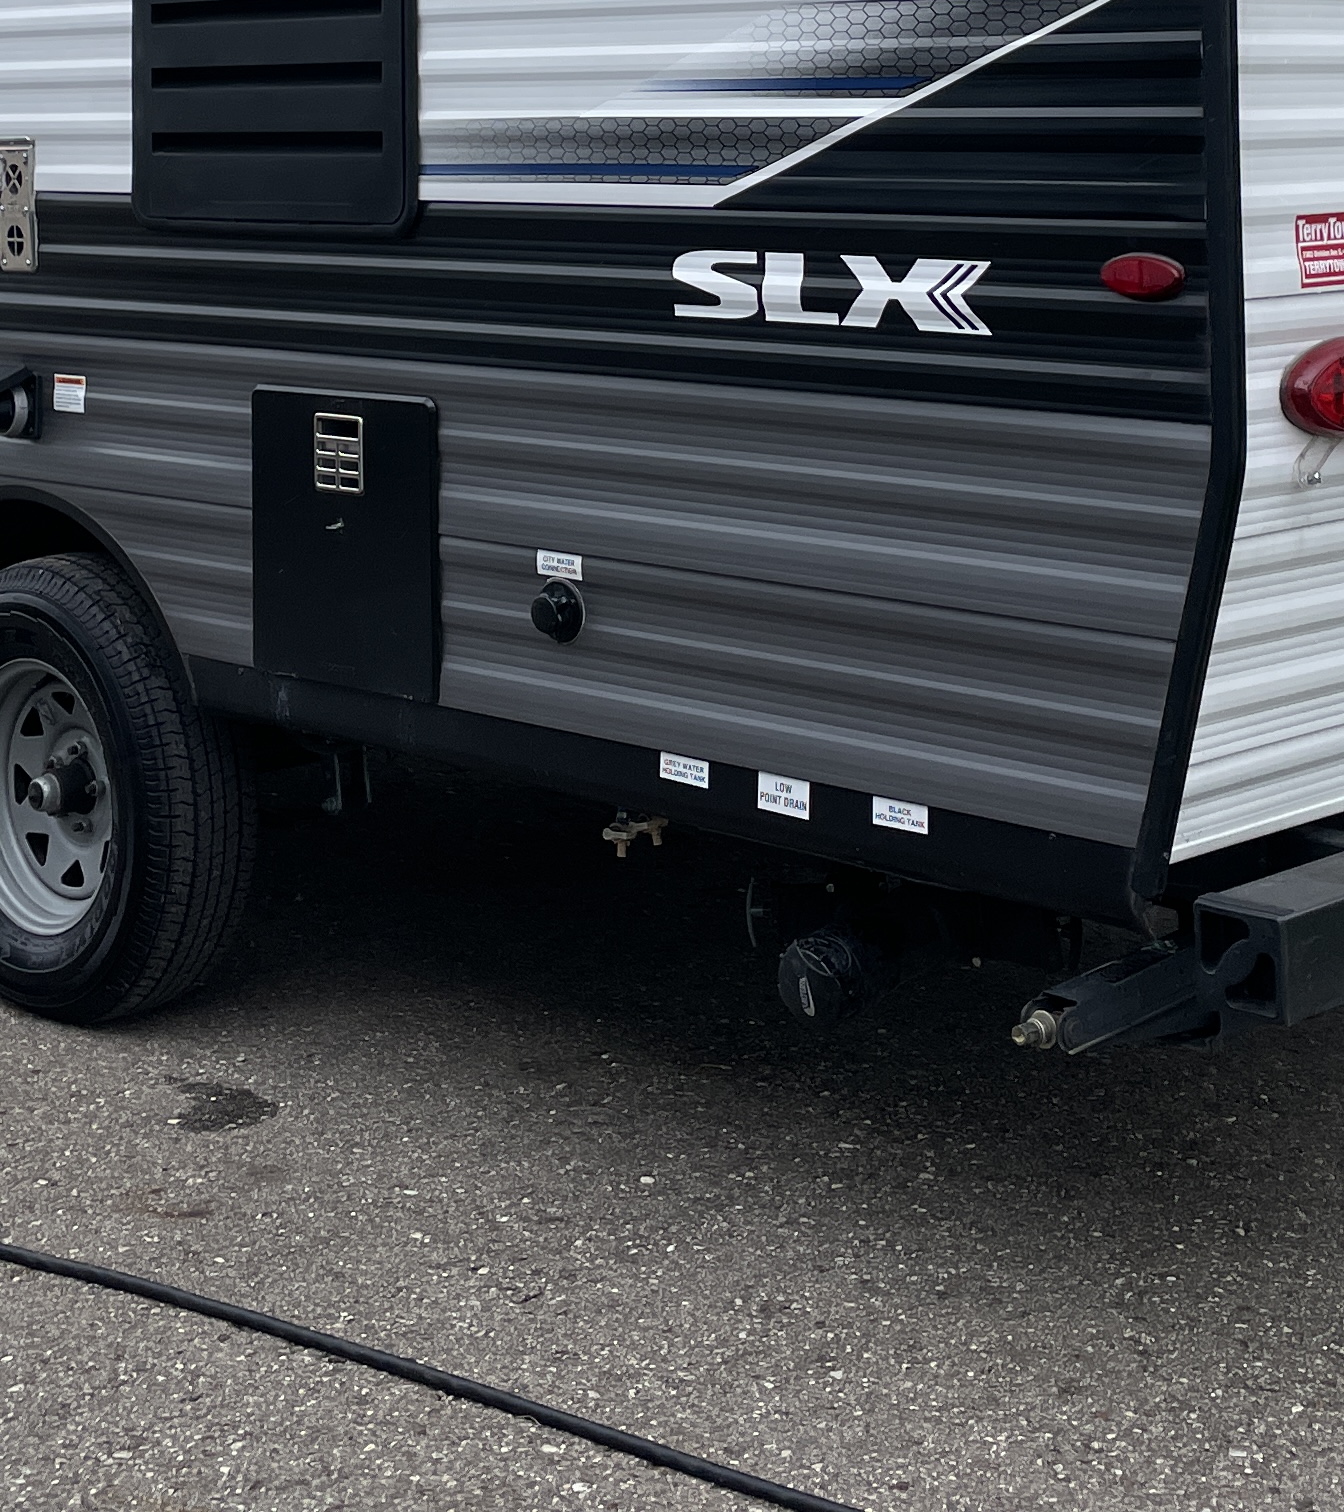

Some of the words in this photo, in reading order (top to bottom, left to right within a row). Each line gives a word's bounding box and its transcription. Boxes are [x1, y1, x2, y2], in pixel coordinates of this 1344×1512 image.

[672, 250, 992, 335] SLX
[662, 768, 688, 778] HOLDING
[690, 773, 706, 783] TANK
[683, 763, 704, 773] WATER
[775, 781, 792, 794] LOW
[760, 791, 782, 805] POINT
[784, 797, 807, 811] DRAIN
[889, 806, 911, 816] BLACK
[876, 813, 905, 824] HOLDING
[907, 818, 925, 828] TANK
